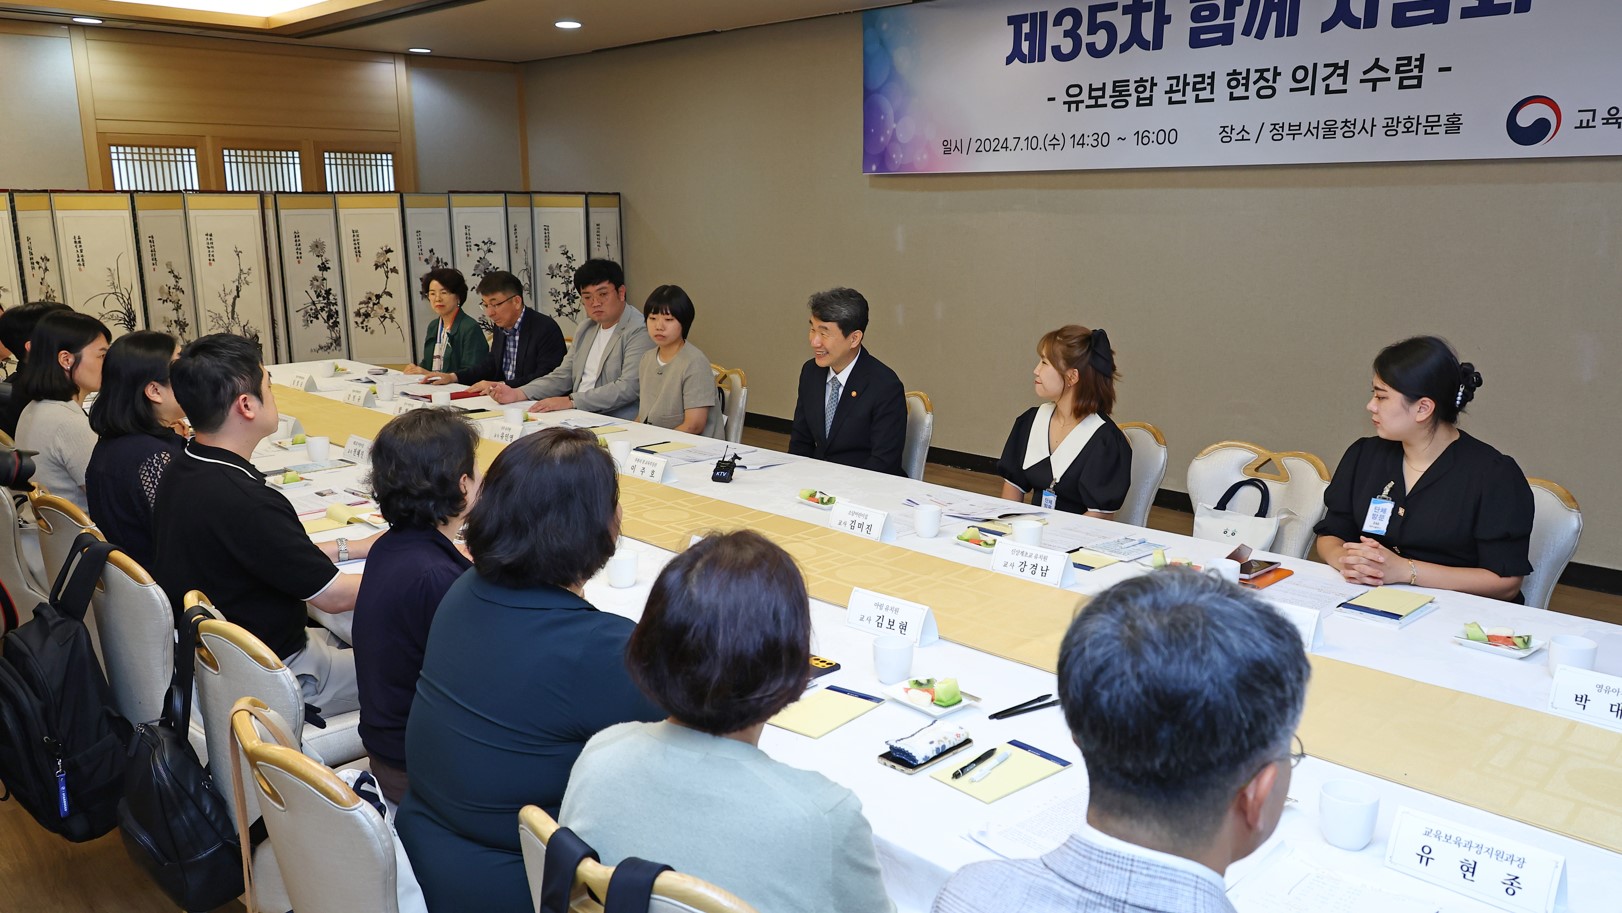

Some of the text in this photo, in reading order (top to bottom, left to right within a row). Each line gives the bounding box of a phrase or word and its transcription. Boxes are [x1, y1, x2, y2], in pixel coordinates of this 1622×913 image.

[1005, 0, 1172, 66] 제35차
[1188, 0, 1300, 49] 함께
[1063, 77, 1158, 112] 유보통합
[1164, 71, 1216, 105] 관련
[1226, 66, 1282, 101] 현장
[1289, 60, 1350, 96] 의견
[1359, 53, 1426, 92] 수렴
[1218, 124, 1251, 143] 장소
[1269, 117, 1377, 142] 정부서울청사
[1381, 112, 1464, 137] 광화문홀
[1574, 106, 1622, 129] 교육
[942, 138, 963, 155] 일시
[975, 132, 1066, 153] 2024.7.10.(수)
[1069, 132, 1111, 149] 14:30
[1133, 128, 1178, 146] 16:00
[875, 614, 908, 636] 김보현
[1595, 683, 1622, 697] 영유아
[1423, 827, 1527, 869] 교육보육과정지원과장
